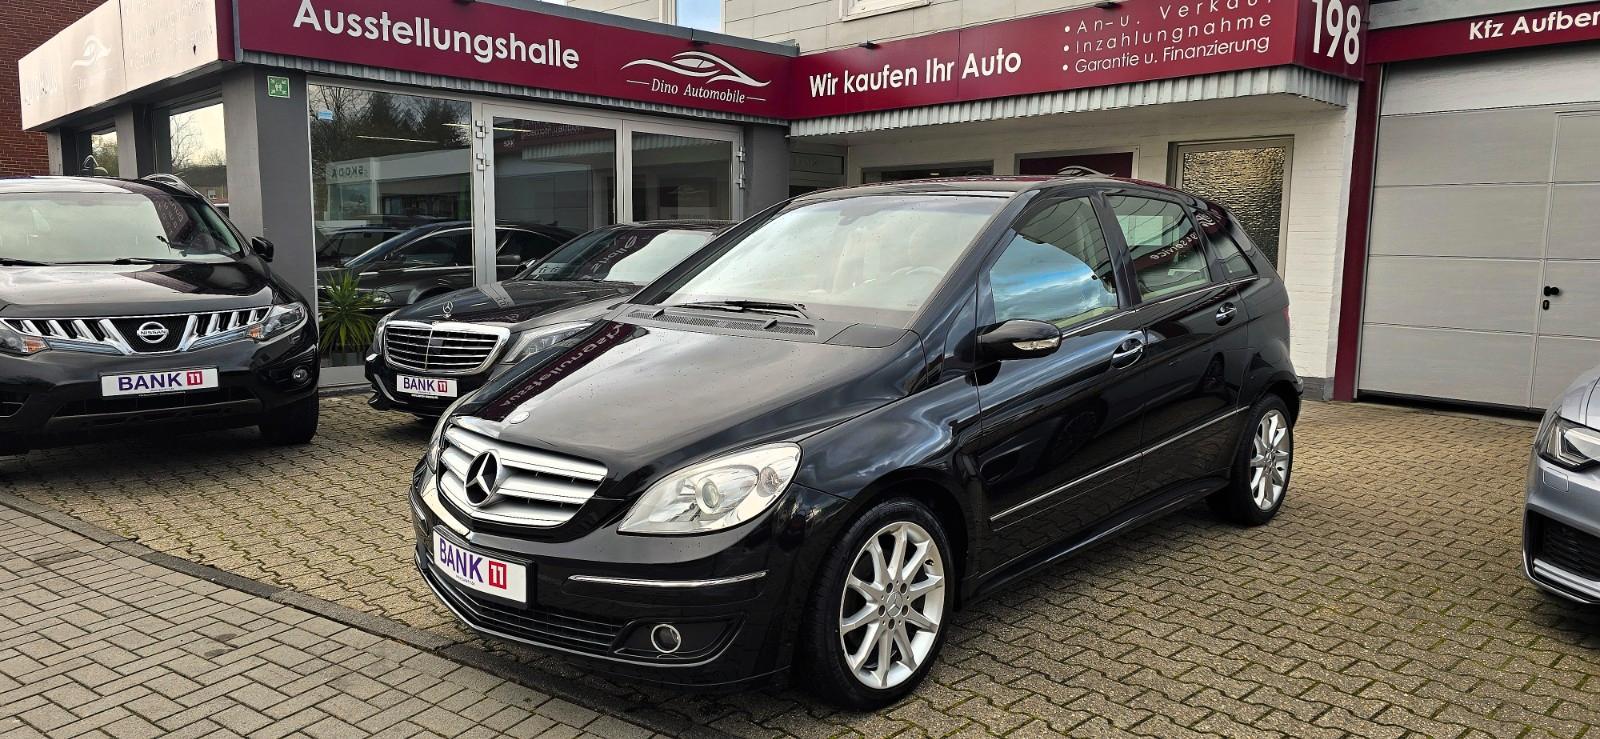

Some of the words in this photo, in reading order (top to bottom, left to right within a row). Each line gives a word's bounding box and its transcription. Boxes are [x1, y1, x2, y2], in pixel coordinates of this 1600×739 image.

[1159, 0, 1271, 20] Verkau
[293, 0, 580, 69] Ausstellungshalle
[1076, 14, 1271, 54] Inzahlungnahme
[1312, 0, 1361, 65] 198
[1469, 19, 1504, 40] Kfz
[809, 73, 839, 97] Wir
[843, 64, 918, 94] kaufen
[925, 57, 955, 84] Ihr
[962, 47, 1022, 80] Auto
[1075, 52, 1139, 73] Garantie
[1144, 51, 1158, 64] u.
[1163, 36, 1270, 62] Finanzierung
[651, 78, 679, 95] Dino
[683, 83, 745, 104] Automobile
[118, 373, 183, 391] BANK
[188, 372, 202, 385] 11
[403, 377, 435, 392] BANK
[438, 381, 447, 392] 11
[440, 536, 484, 583] BANK
[490, 561, 506, 588] 11
